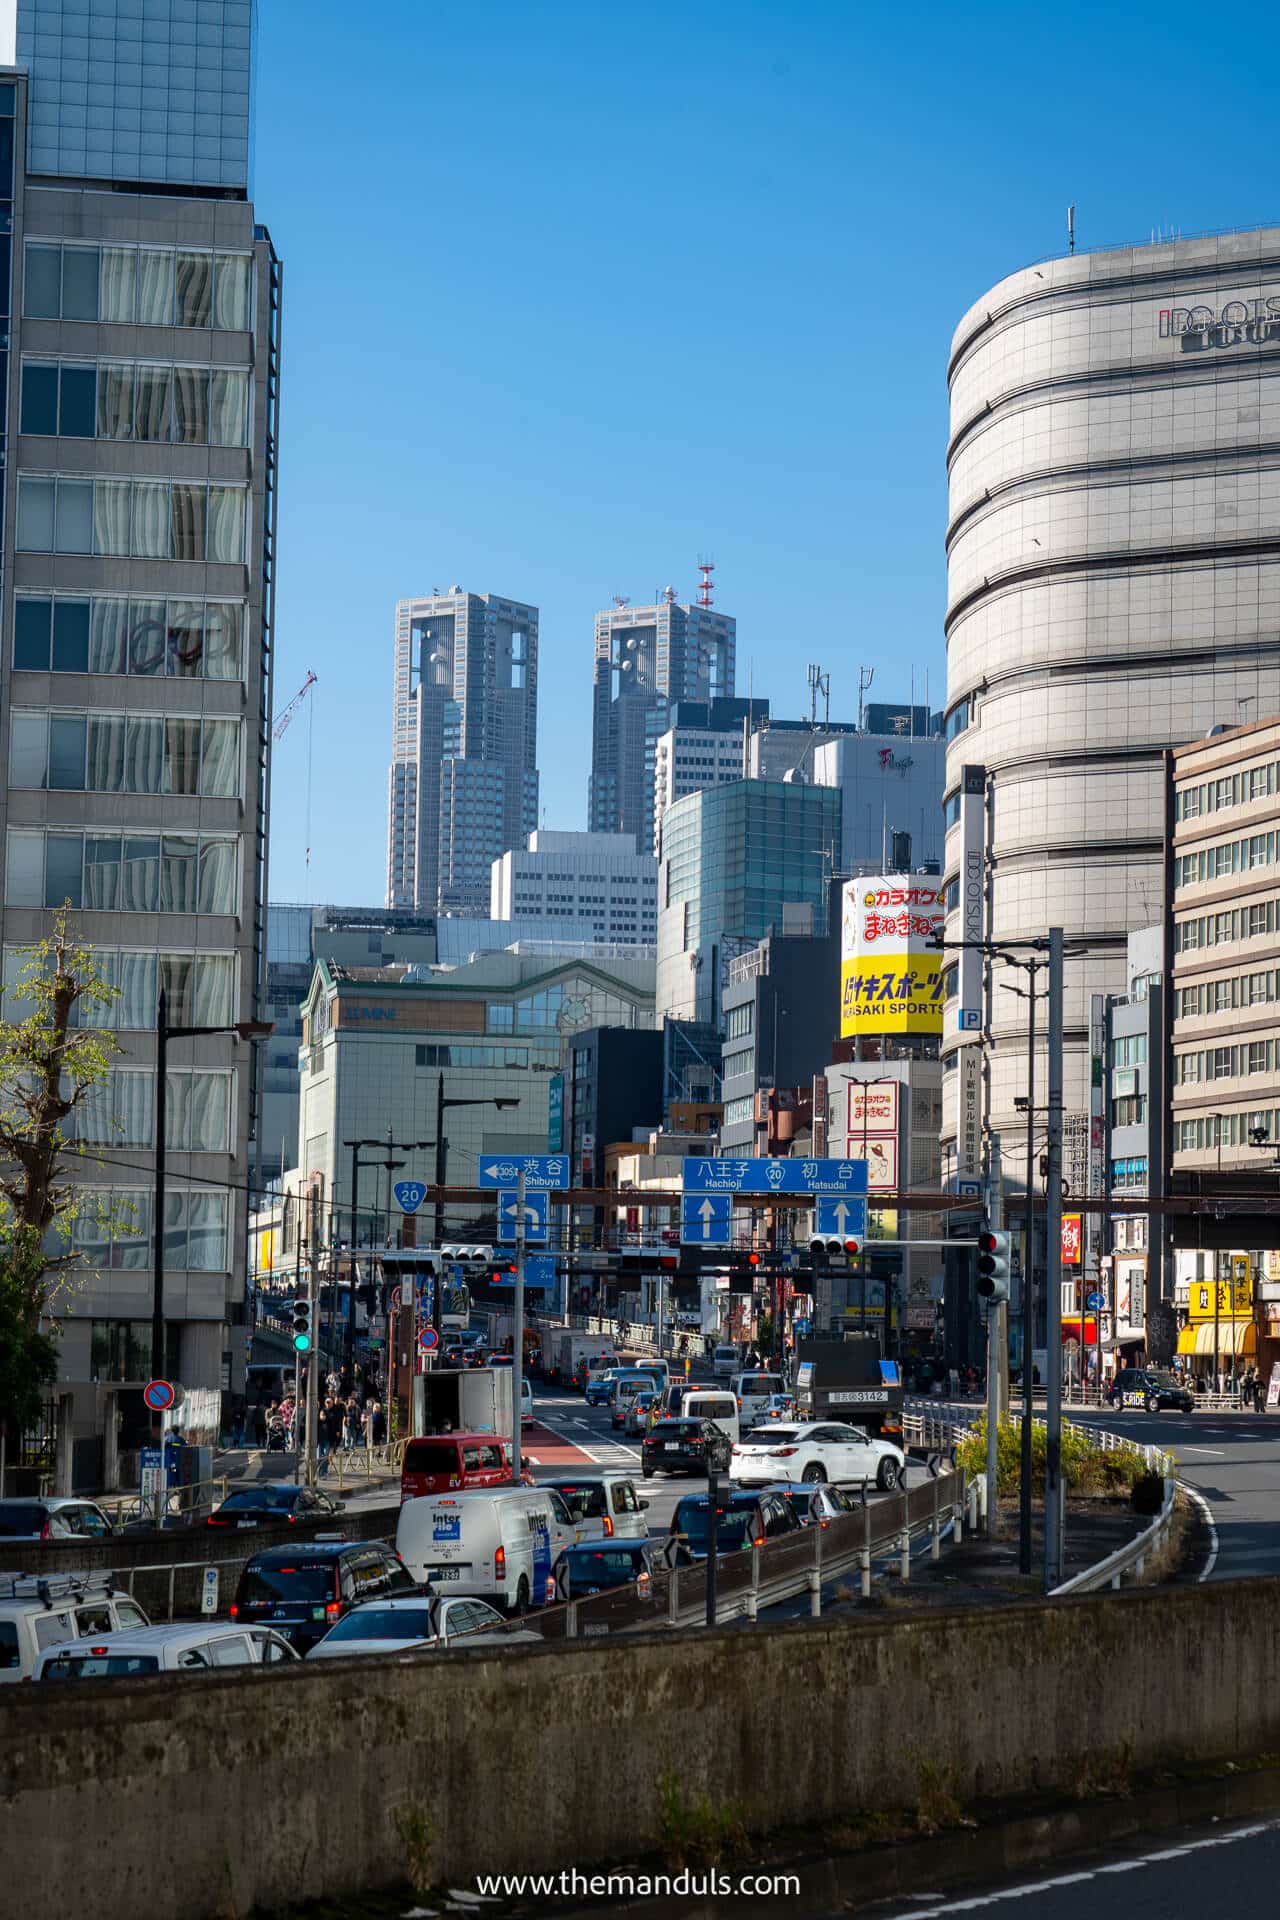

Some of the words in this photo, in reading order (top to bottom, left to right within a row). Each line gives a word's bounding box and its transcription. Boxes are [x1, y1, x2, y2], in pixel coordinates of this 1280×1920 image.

[875, 888, 938, 906] カラオケ
[523, 1158, 563, 1175] 渋谷
[698, 1161, 750, 1177] 八王子
[801, 1162, 854, 1180] 初台
[770, 1169, 781, 1180] 20
[524, 1176, 560, 1187] Shibuya
[705, 1179, 742, 1191] Hachioji
[807, 1180, 847, 1190] Hatsudai
[401, 1190, 419, 1202] 20
[449, 1479, 461, 1488] EV
[432, 1513, 461, 1523] Inter
